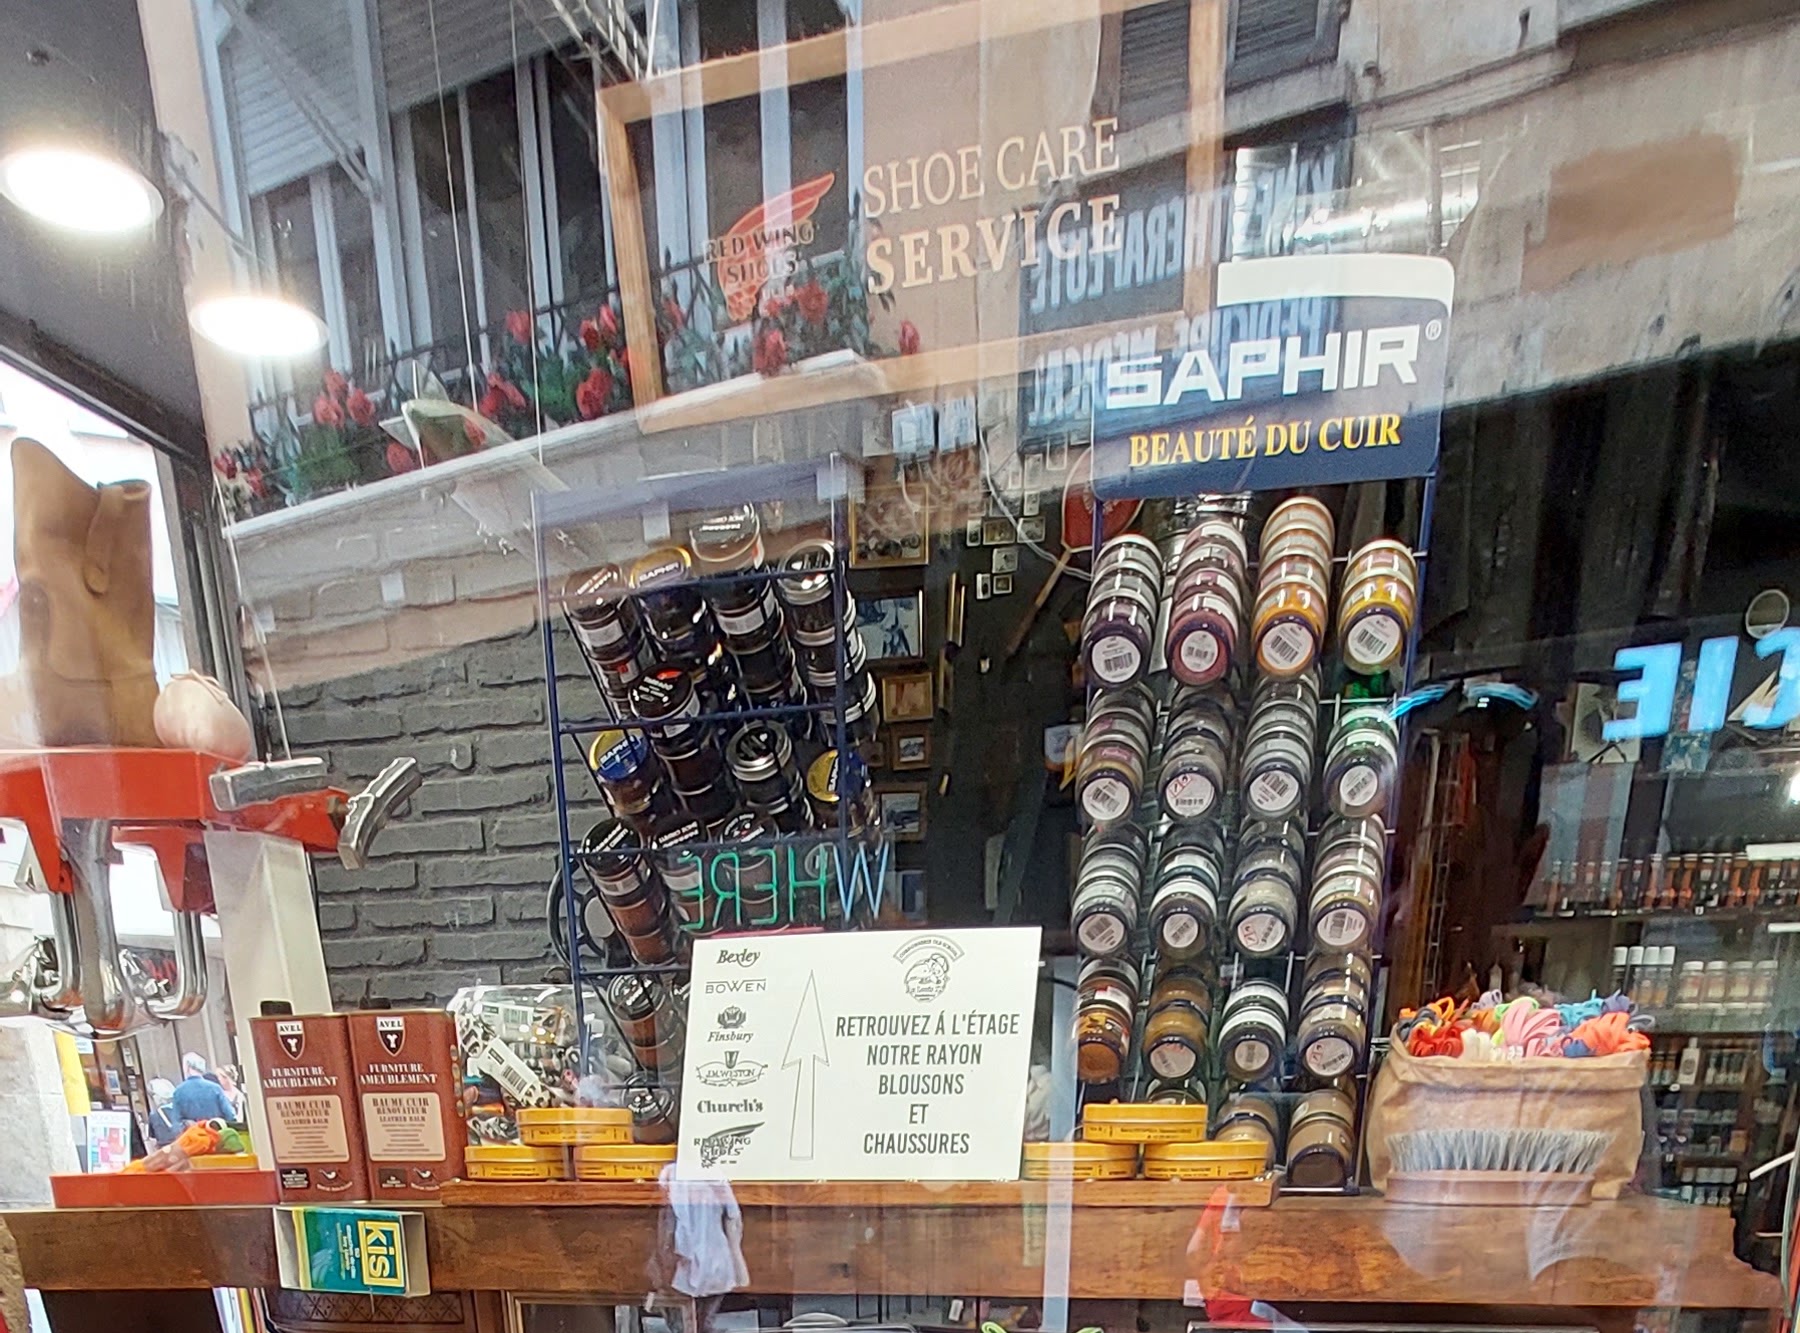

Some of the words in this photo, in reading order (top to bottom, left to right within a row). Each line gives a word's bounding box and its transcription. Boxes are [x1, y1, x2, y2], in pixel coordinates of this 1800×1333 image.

[862, 141, 990, 219] SHOE
[999, 117, 1121, 190] CARE
[703, 236, 745, 262] RED
[753, 219, 814, 250] WING
[867, 194, 1122, 296] SERVICE
[1129, 417, 1256, 470] BEAUTÉ
[1264, 420, 1310, 460] DU
[1319, 413, 1402, 452] CUIR
[639, 562, 680, 582] SAPHIR
[717, 948, 760, 967] Bexley
[705, 977, 767, 994] BOWEN
[279, 1023, 302, 1033] AVEL
[379, 1019, 403, 1029] AVEL
[835, 1014, 930, 1037] RETROUVEZ
[951, 1009, 1020, 1036] L'ÉTAGE
[707, 1030, 754, 1044] Finsbury
[867, 1044, 920, 1066] NOTRE
[926, 1043, 983, 1066] RAYON
[271, 1065, 326, 1078] FURNITURE
[369, 1062, 424, 1074] FURNITURE
[263, 1075, 338, 1089] AMEUBLEMENT
[359, 1073, 438, 1086] AMEUBLEMENT
[878, 1073, 965, 1096] BLOUSONS
[276, 1101, 307, 1111] BAUME
[309, 1099, 332, 1110] CUIR
[372, 1097, 404, 1107] BAUME
[406, 1097, 430, 1107] CUIR
[697, 1098, 764, 1114] Church's
[908, 1103, 929, 1125] ET
[863, 1132, 971, 1155] CHAUSSURES
